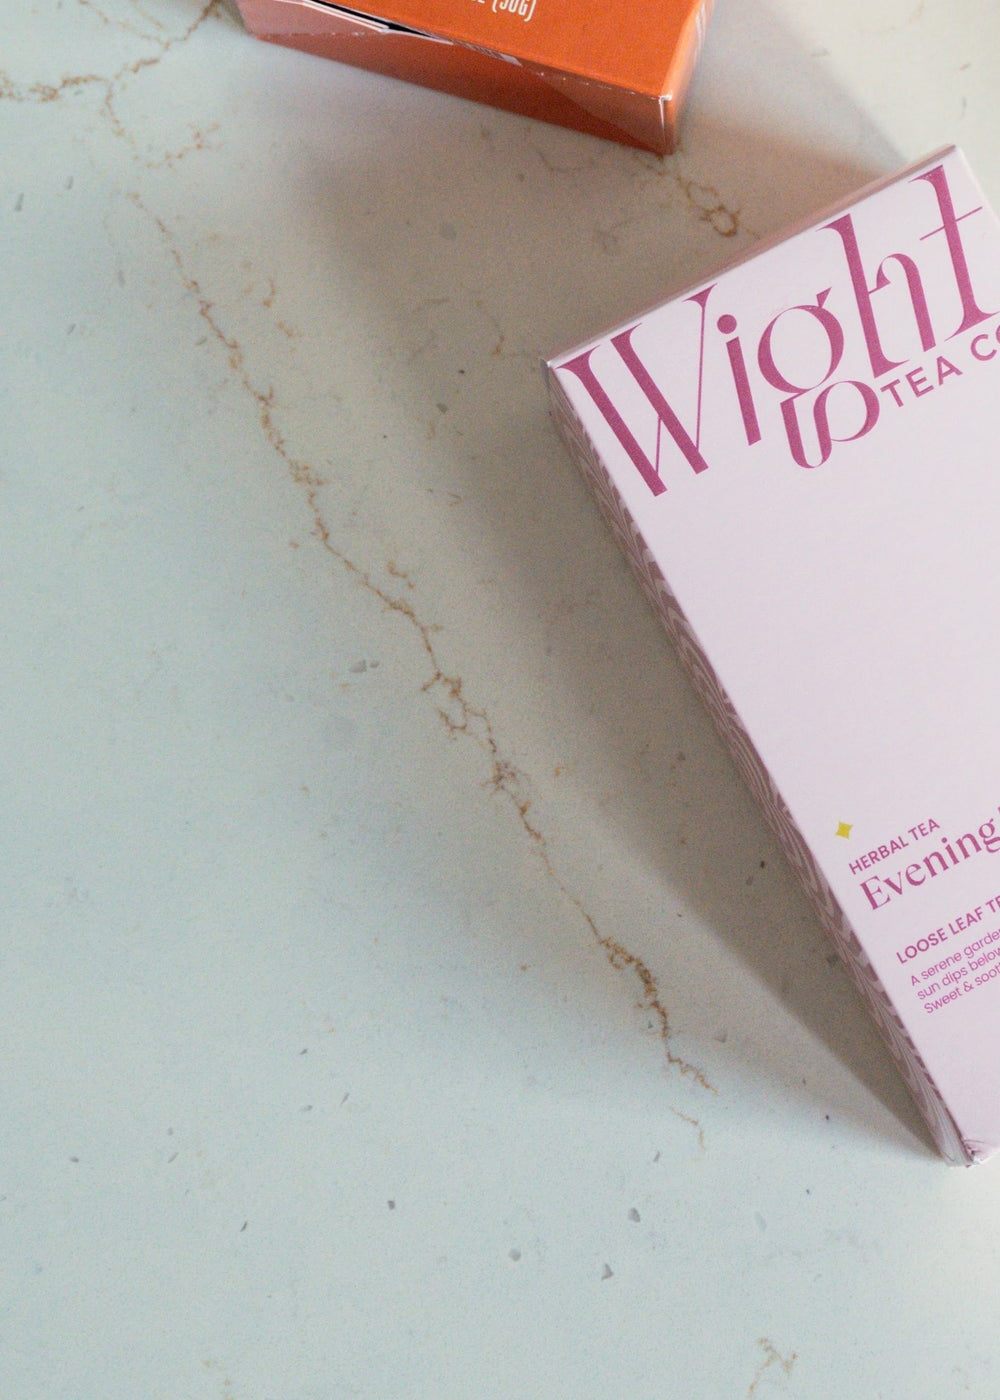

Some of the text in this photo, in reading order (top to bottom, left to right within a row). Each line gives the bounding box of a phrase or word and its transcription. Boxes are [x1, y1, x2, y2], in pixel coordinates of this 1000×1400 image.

[881, 356, 962, 407] TEA
[849, 818, 940, 875] HERBAL TEA
[896, 930, 948, 964] LOOSE
[950, 910, 985, 936] LEAF
[910, 975, 921, 987] A
[922, 951, 962, 981] serene
[917, 982, 939, 1000] sun
[941, 967, 968, 991] dips
[923, 987, 961, 1013] Sweet
[963, 980, 974, 991] &
